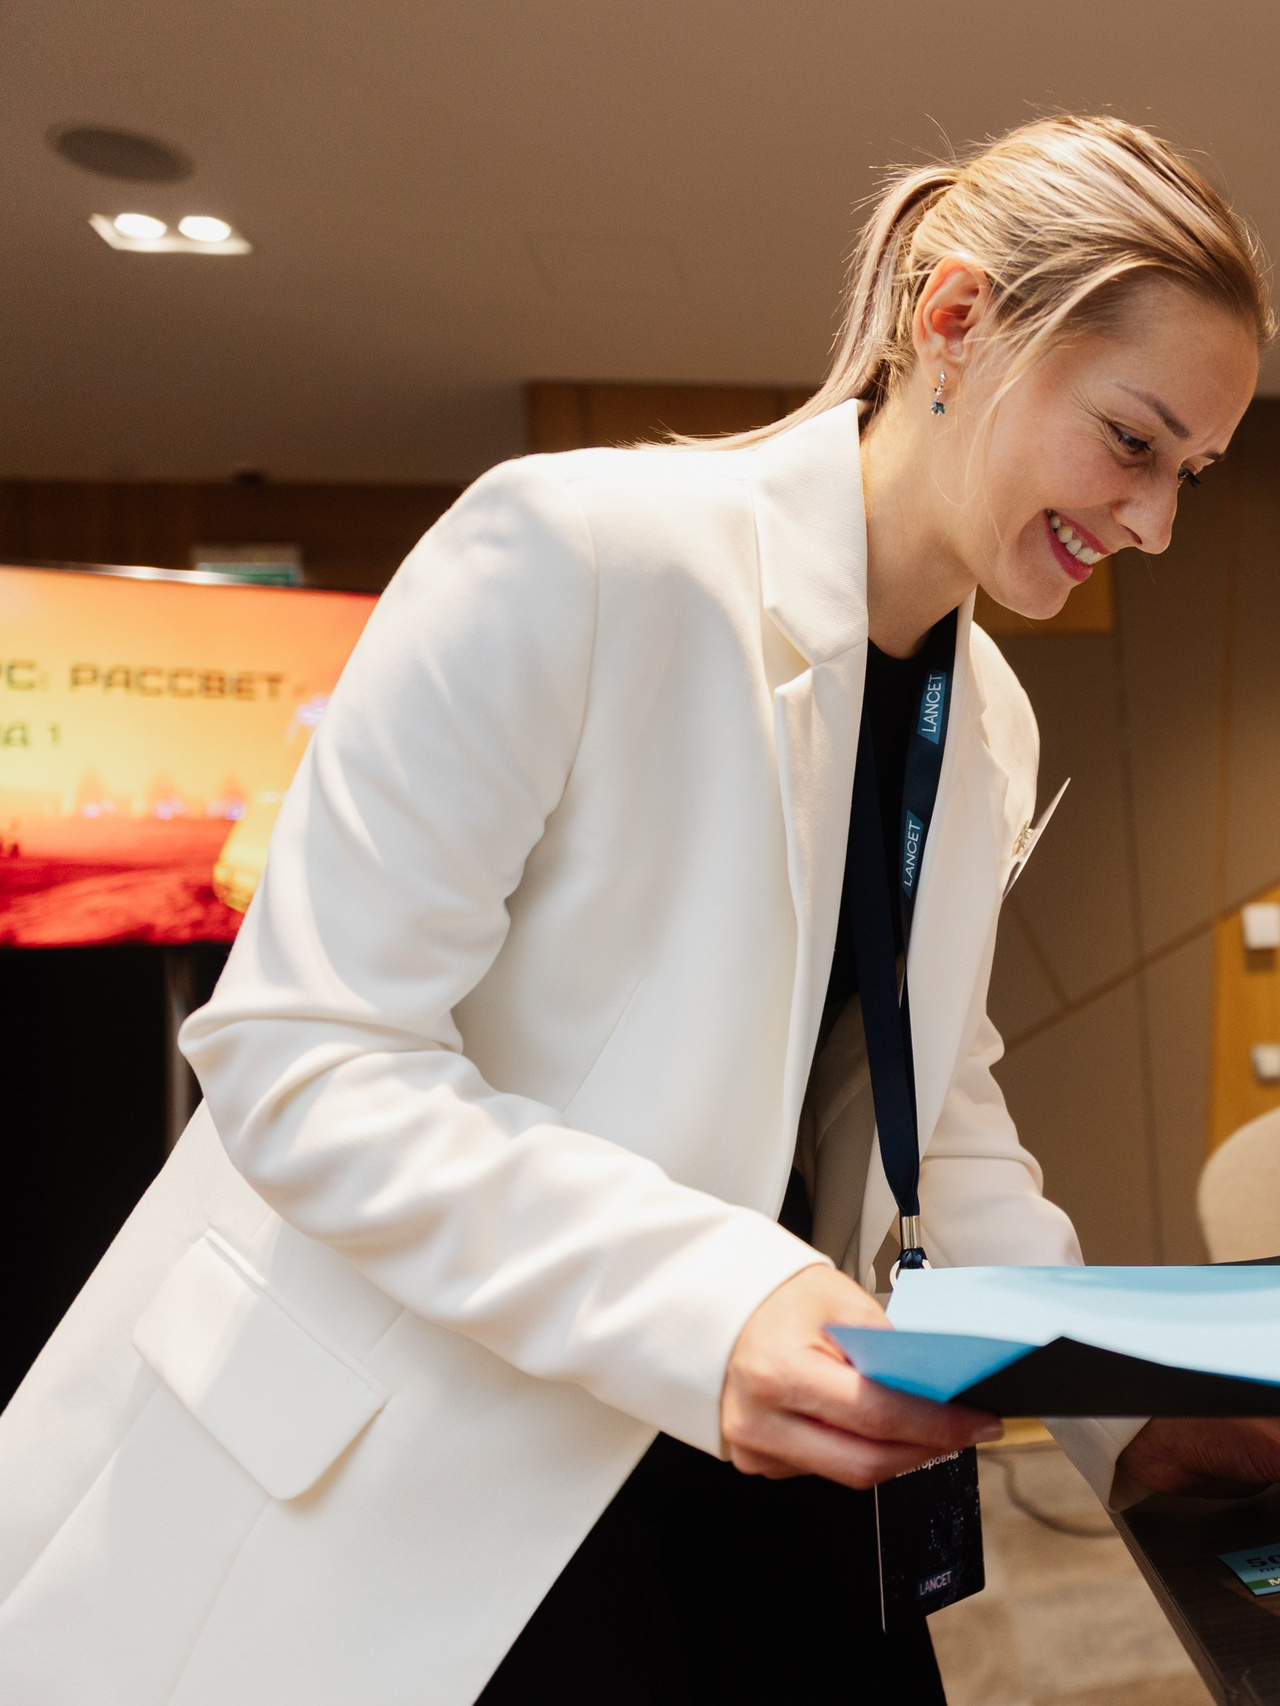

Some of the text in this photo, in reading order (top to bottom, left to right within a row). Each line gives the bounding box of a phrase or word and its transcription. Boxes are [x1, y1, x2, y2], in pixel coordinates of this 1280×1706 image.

[70, 662, 285, 702] РАССВЕТ
[922, 673, 943, 733] LANCET
[903, 819, 921, 887] LANCET
[896, 1449, 959, 1478] оровна
[919, 1570, 952, 1596] LANCET
